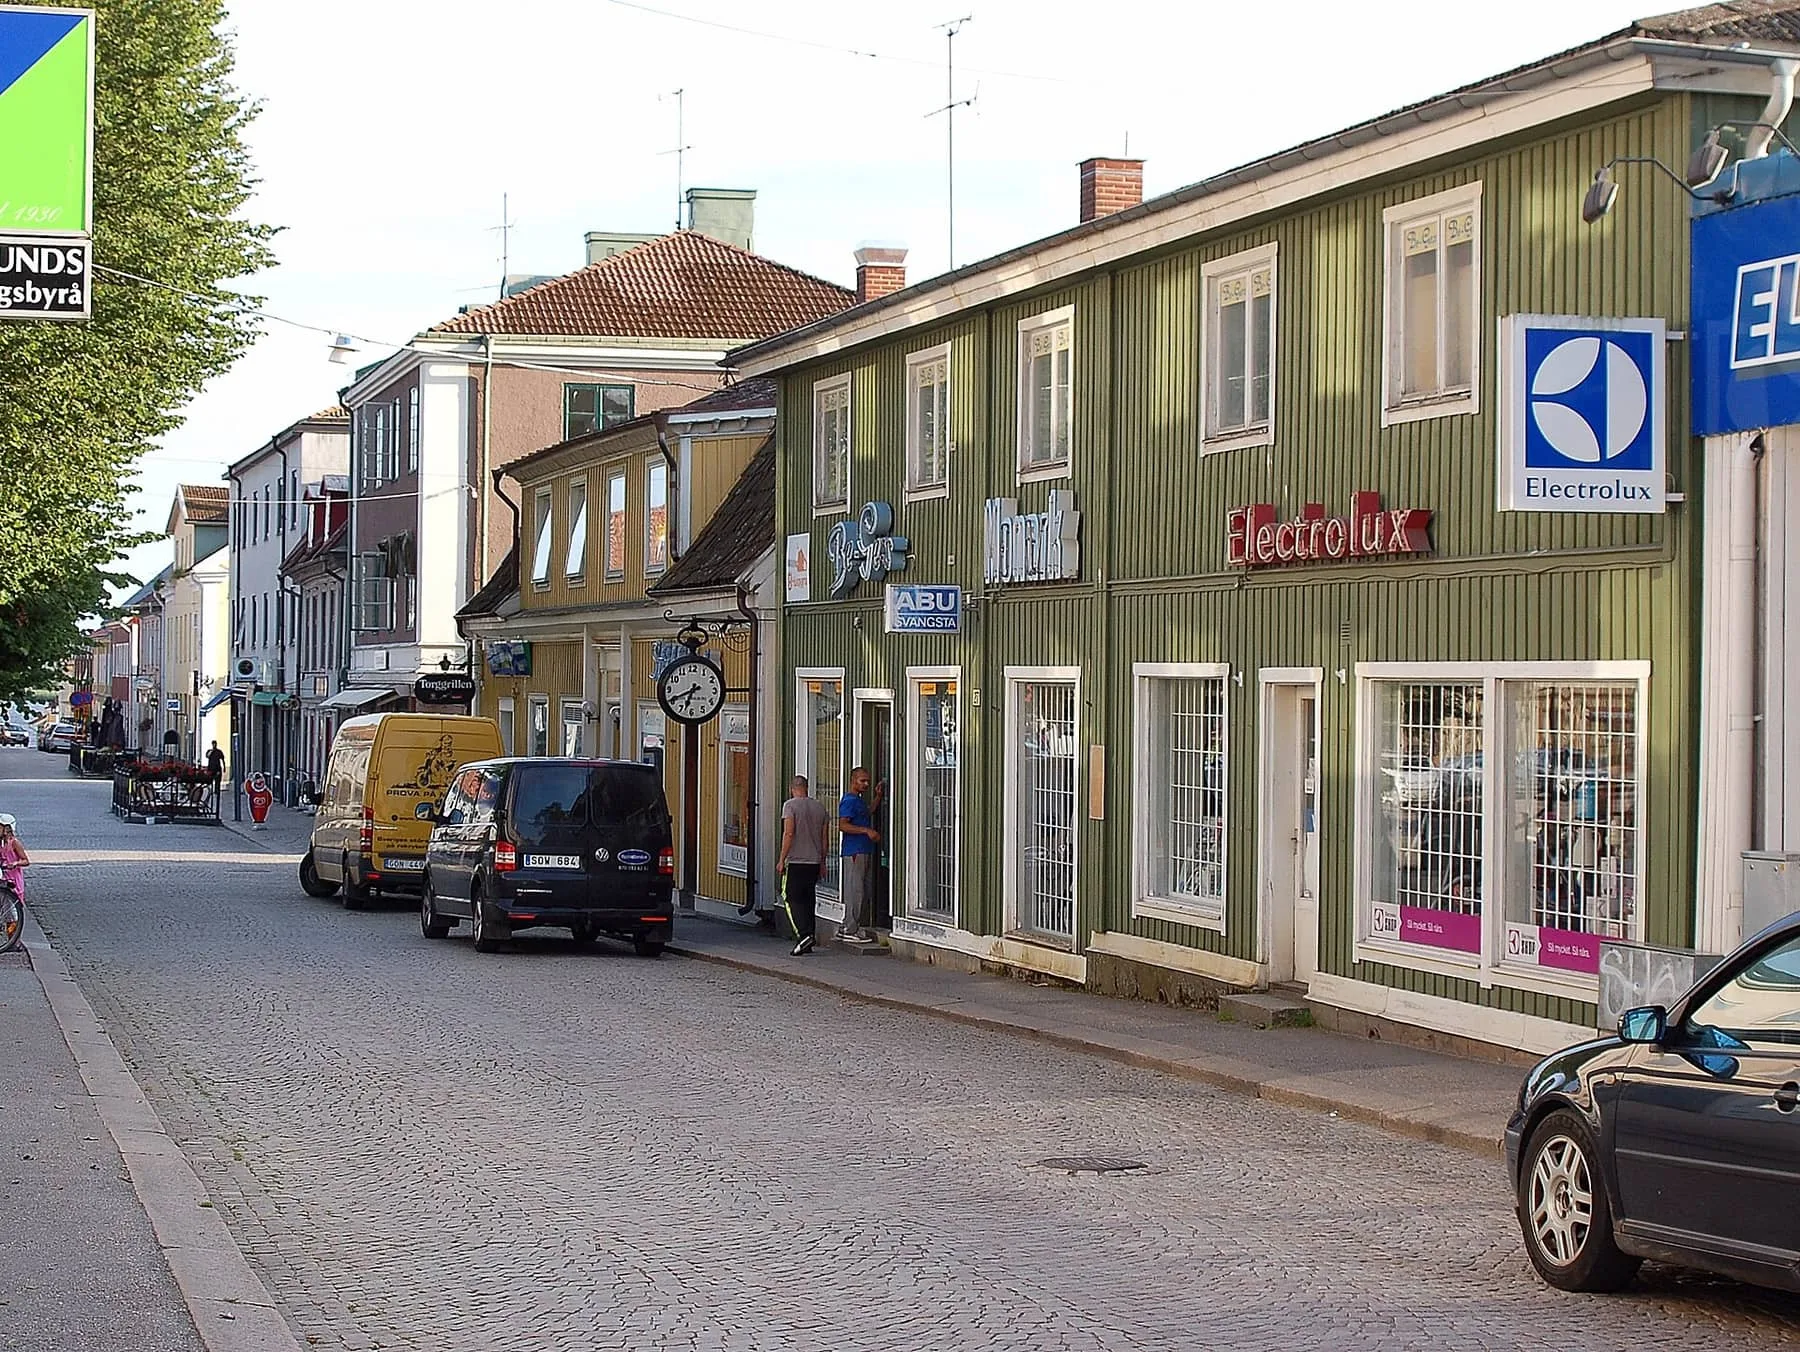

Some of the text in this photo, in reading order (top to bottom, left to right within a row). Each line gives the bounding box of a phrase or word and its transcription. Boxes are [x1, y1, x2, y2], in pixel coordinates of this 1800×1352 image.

[16, 205, 62, 223] 1930
[0, 247, 83, 275] UNDS
[0, 279, 82, 310] gsbyrå
[1526, 476, 1652, 501] Electrolux
[1227, 491, 1422, 566] Electrolux
[984, 488, 1070, 584] Monark
[897, 591, 955, 611] ABU
[678, 667, 686, 676] 11
[688, 665, 698, 673] 12
[702, 669, 706, 677] 1
[670, 675, 679, 683] 10
[709, 676, 716, 684] 2
[418, 679, 473, 691] Torggrillen
[678, 704, 685, 713] 7
[689, 708, 695, 717] 6
[700, 705, 706, 714] 5
[386, 789, 420, 797] PROVA
[531, 856, 576, 866] SOW 684
